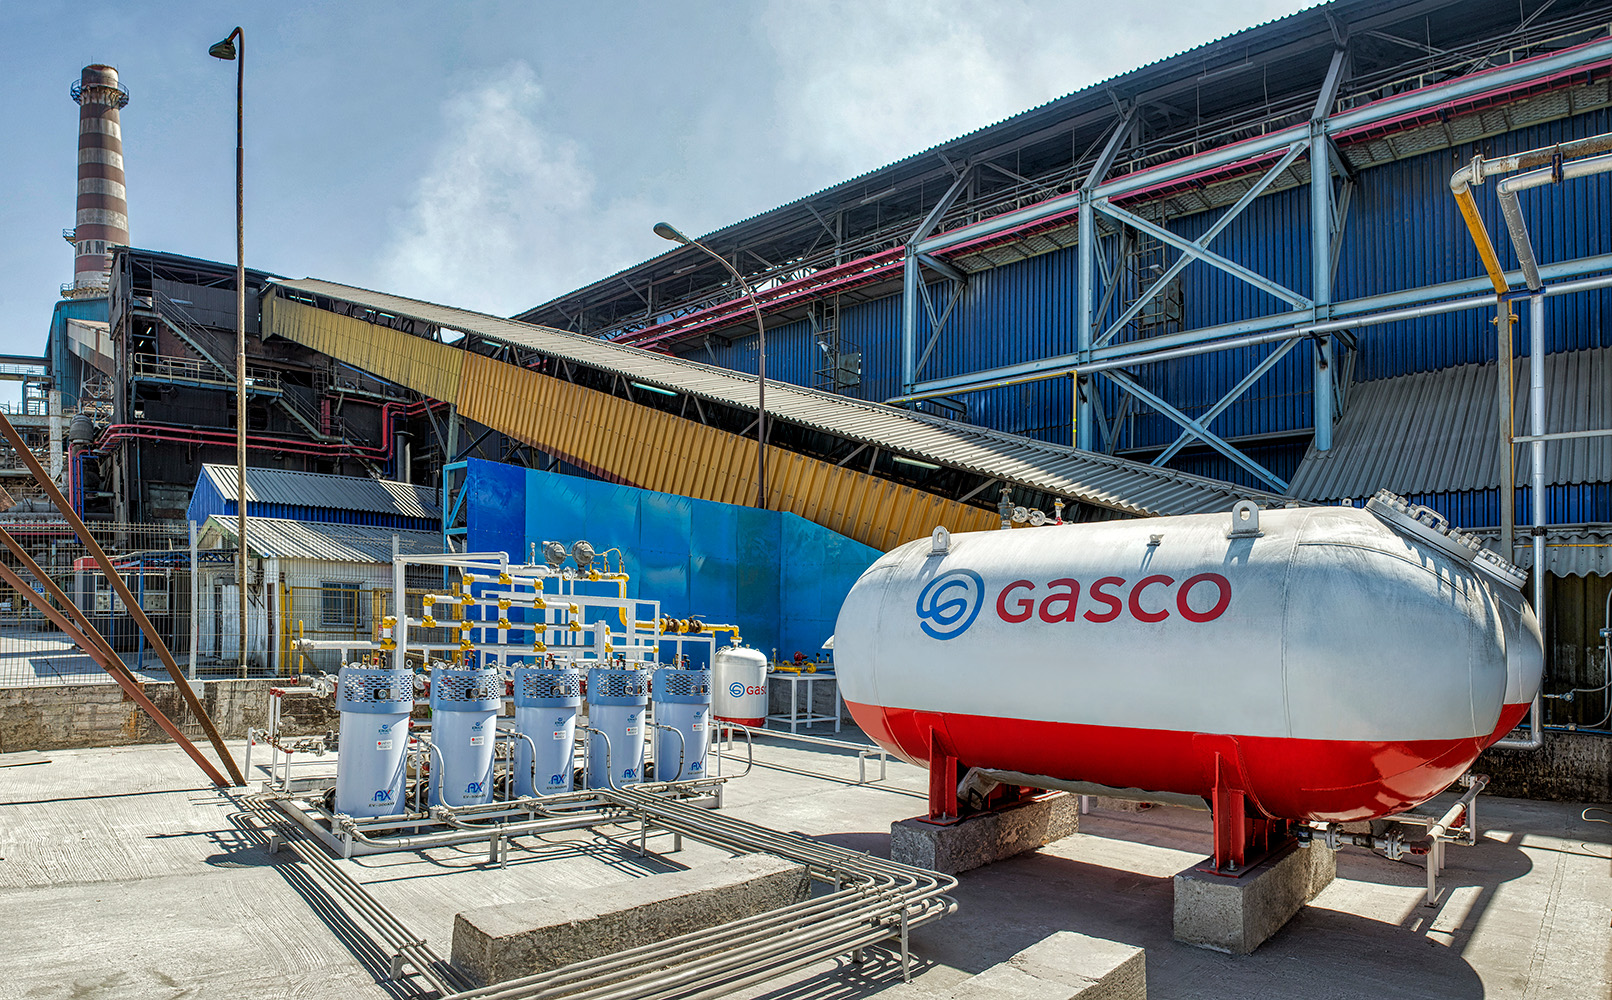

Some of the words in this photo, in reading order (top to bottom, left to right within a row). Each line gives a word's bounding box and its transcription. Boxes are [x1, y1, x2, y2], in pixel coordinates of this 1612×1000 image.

[623, 768, 638, 779] AX
[550, 774, 566, 785] AX
[467, 782, 484, 794] AX
[374, 789, 392, 802] AX
